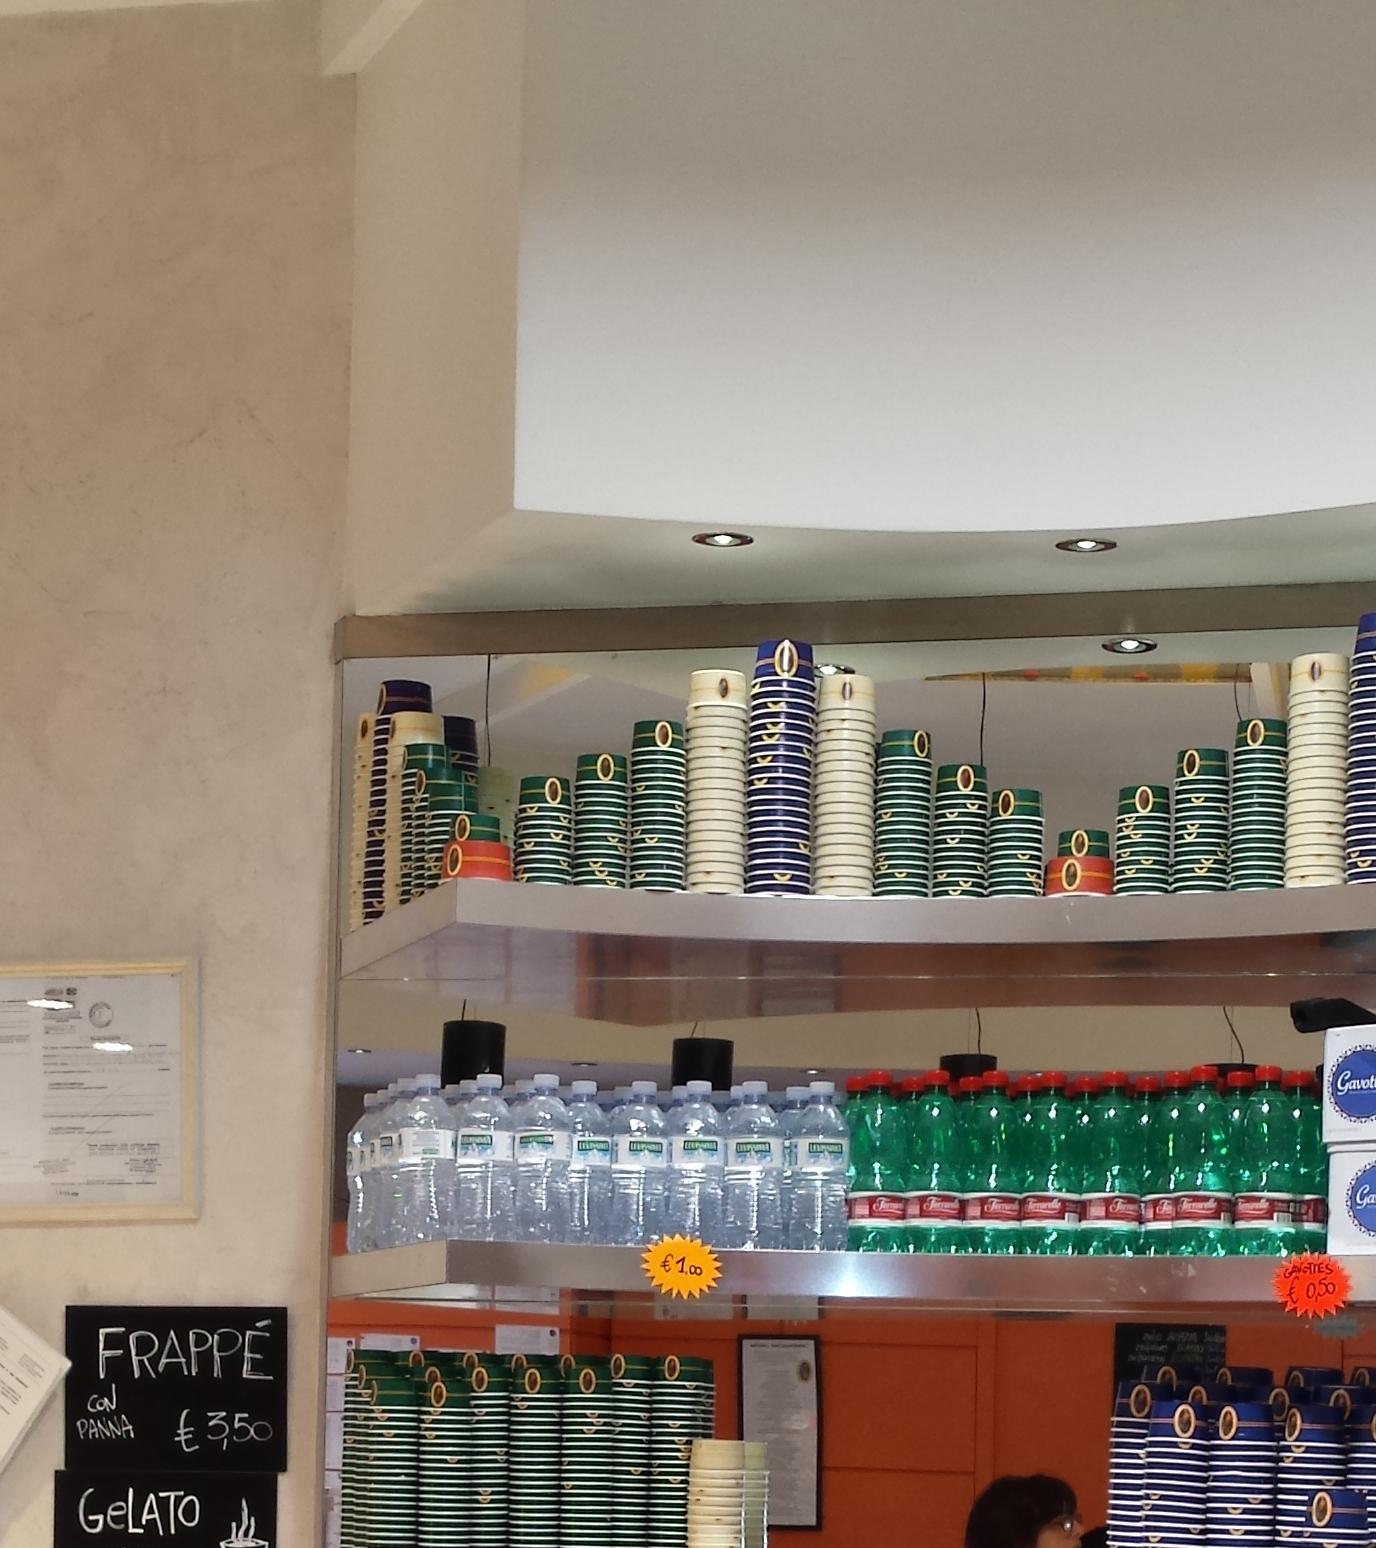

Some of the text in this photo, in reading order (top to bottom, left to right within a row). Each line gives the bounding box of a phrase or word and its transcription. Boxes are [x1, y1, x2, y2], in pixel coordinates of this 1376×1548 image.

[660, 1253, 674, 1272] €
[1287, 1276, 1300, 1304] €
[98, 1319, 274, 1380] FRAPPÉ
[76, 1414, 135, 1440] PANNA
[174, 1409, 273, 1452] € 3,50
